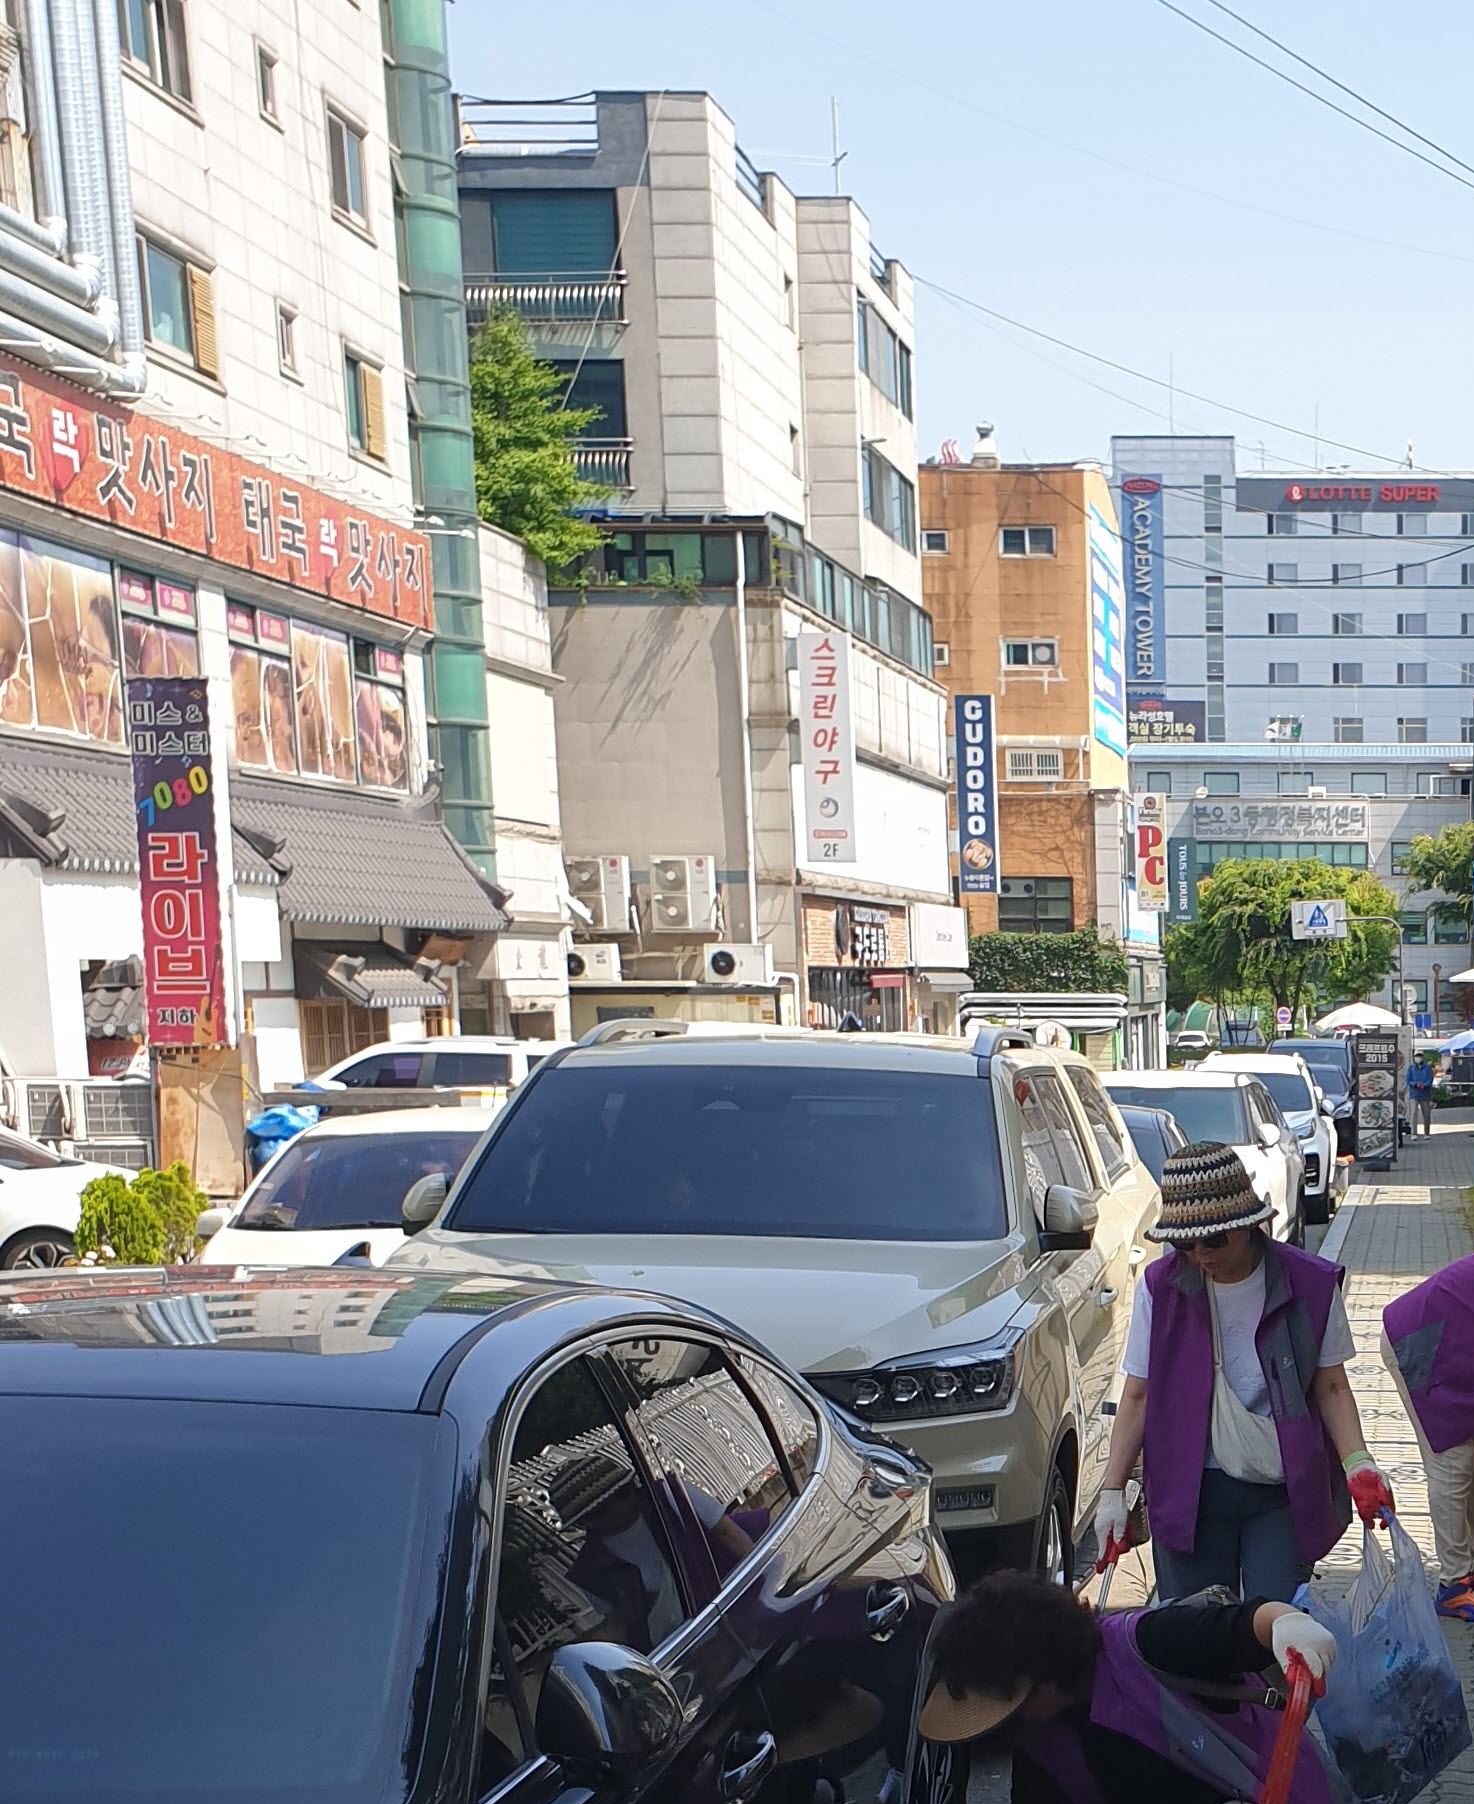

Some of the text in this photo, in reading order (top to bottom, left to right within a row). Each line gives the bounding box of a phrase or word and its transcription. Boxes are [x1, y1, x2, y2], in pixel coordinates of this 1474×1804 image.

[1308, 485, 1439, 502] LOTTE SUPER
[241, 475, 430, 617] 태국락맛사지
[1132, 496, 1153, 598] ACADEMY
[1134, 602, 1155, 677] TOWER
[810, 637, 840, 785] 스크린야구
[1128, 722, 1196, 735] 객실 장기투숙
[132, 731, 209, 756] 미스터
[964, 700, 987, 836] GUDORO
[139, 766, 208, 827] 7080
[823, 843, 839, 857] 2F
[1137, 825, 1165, 886] PC
[1178, 845, 1188, 870] TOUS
[148, 832, 212, 995] 라이브
[1366, 1053, 1388, 1063] 2015
